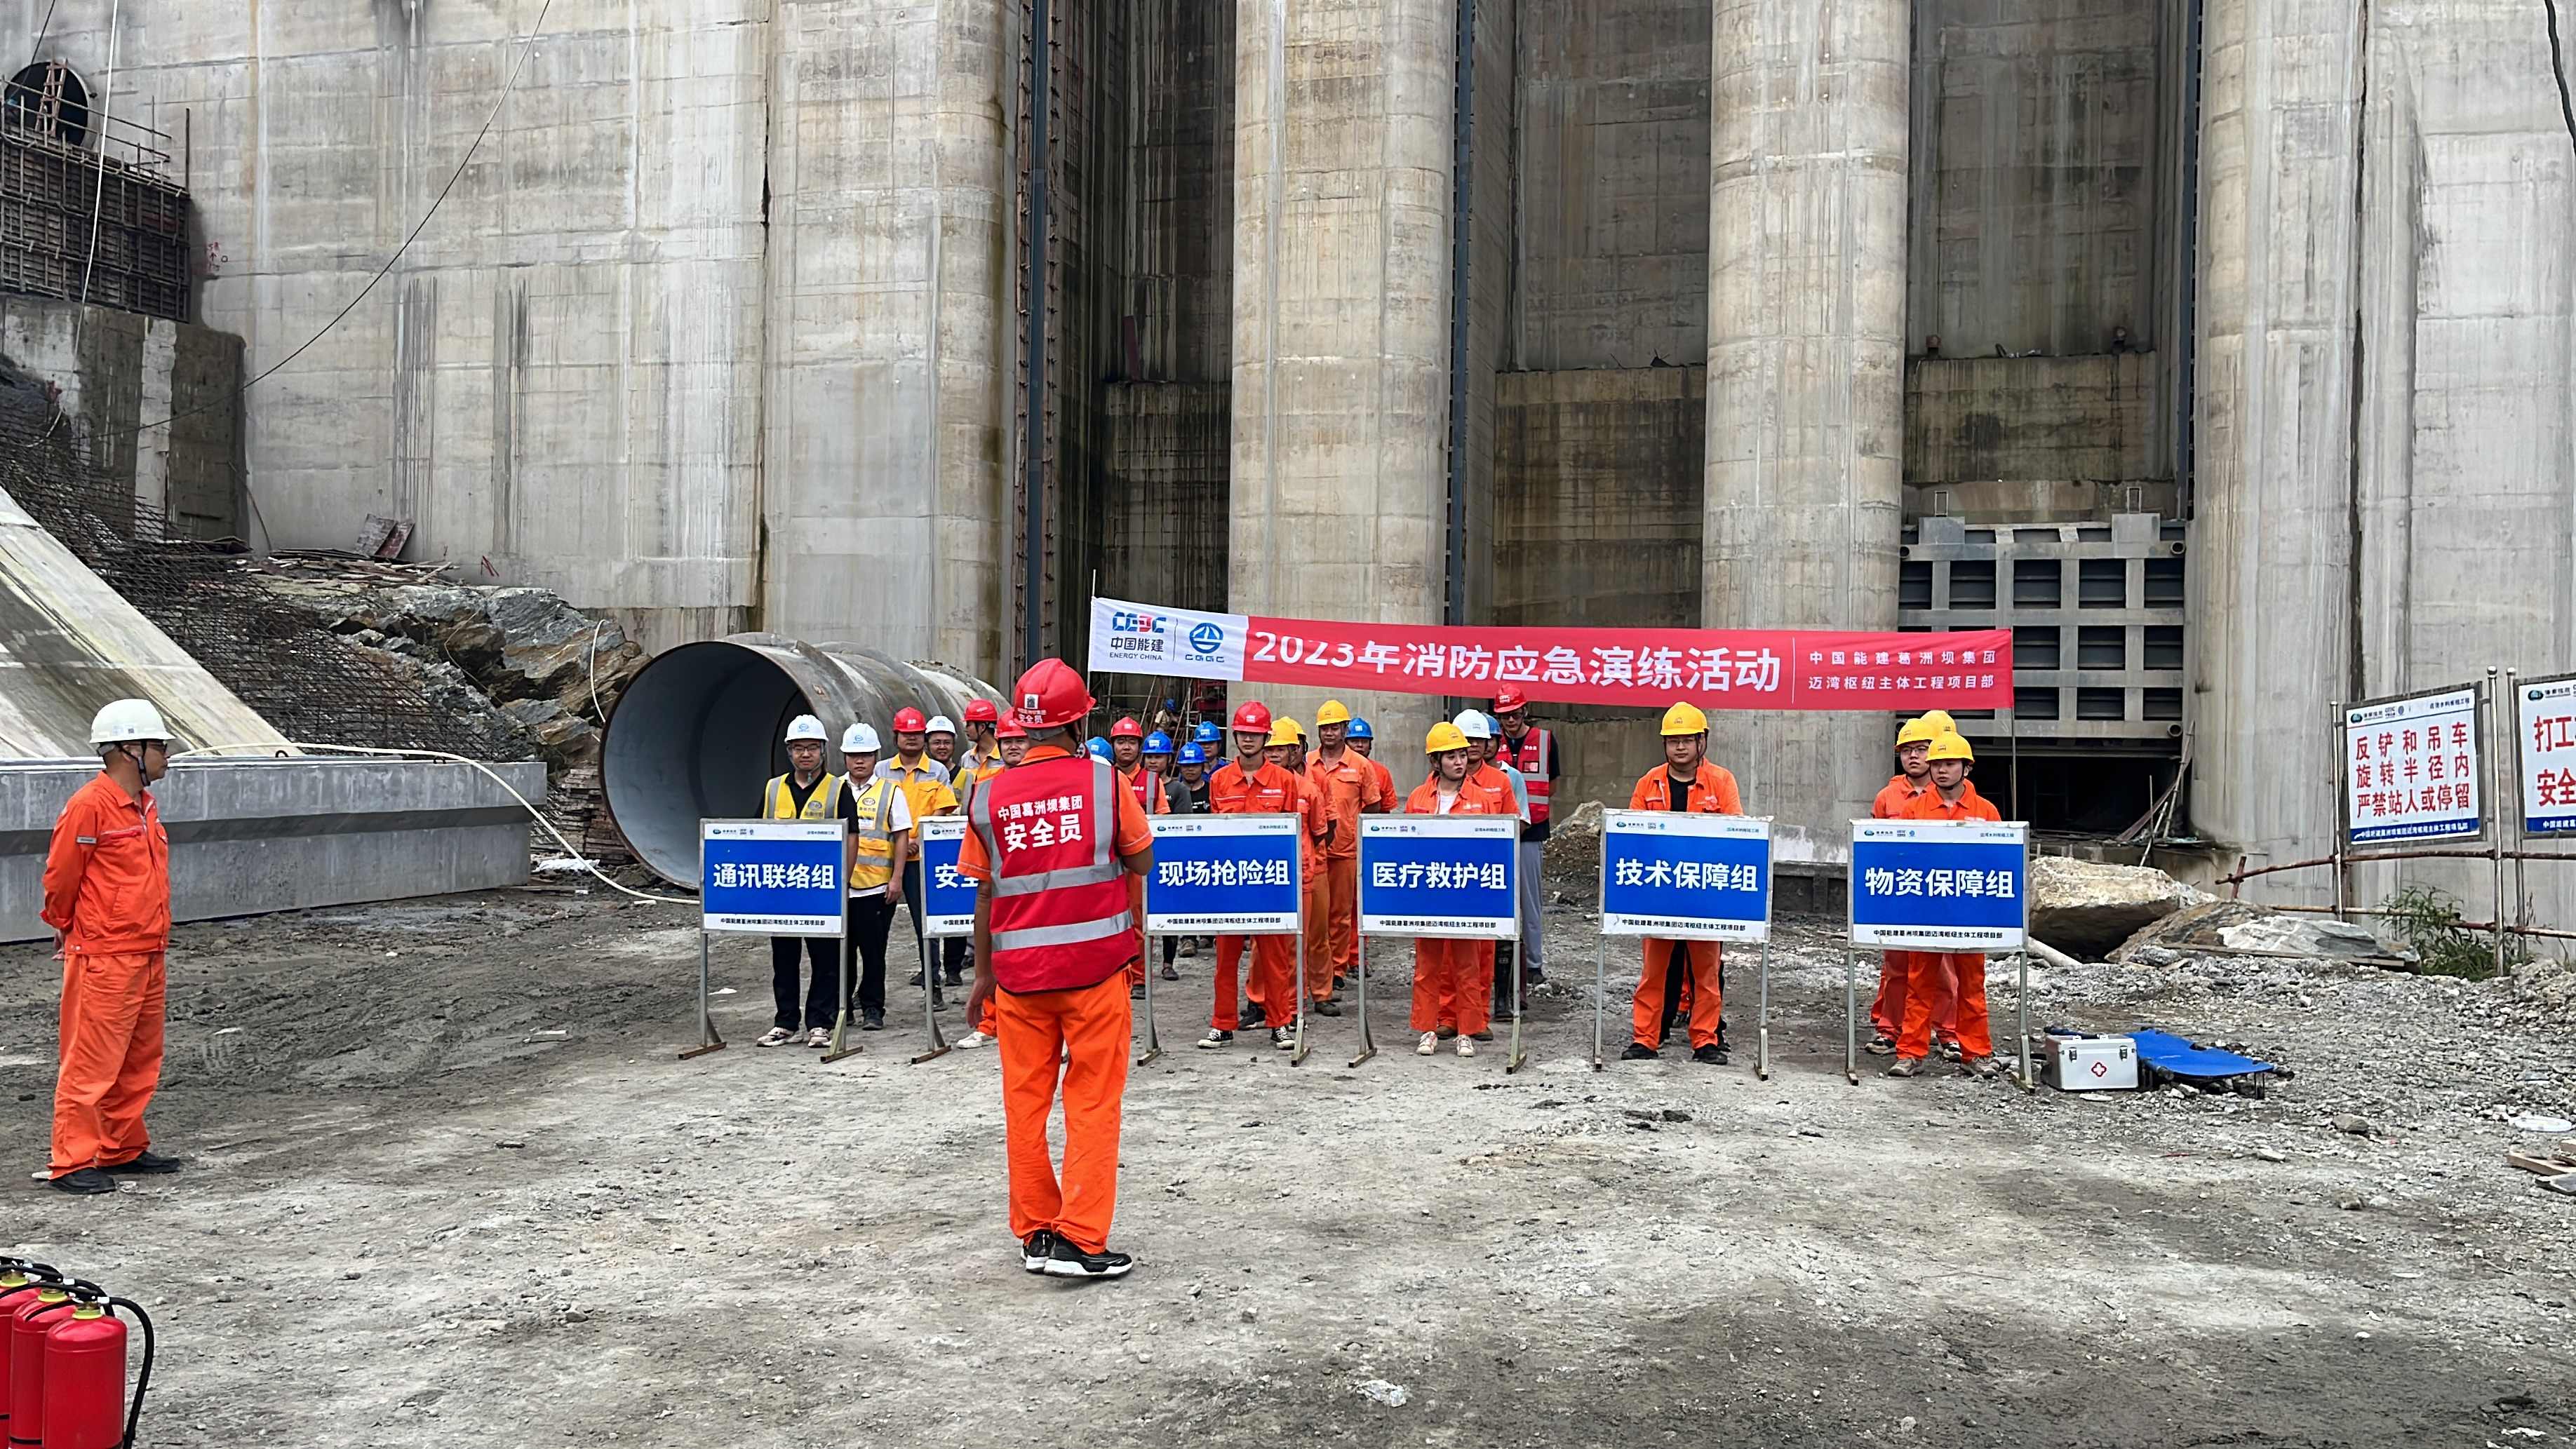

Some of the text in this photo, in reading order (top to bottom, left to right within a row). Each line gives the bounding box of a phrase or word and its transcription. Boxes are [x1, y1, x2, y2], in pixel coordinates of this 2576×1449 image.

[1111, 637, 1165, 652] 中国能建
[1140, 652, 1162, 661] CHINA
[1186, 654, 1225, 663] CGGC
[1809, 651, 1996, 665] 中国能建葛洲坝集团
[1253, 631, 1780, 692] 2023年消防应急演练活动
[1809, 675, 1994, 690] 迈湾枢纽主体工程项目部
[2356, 722, 2468, 761] 反铲和吊车
[2533, 715, 2576, 753] 打工
[2356, 751, 2469, 789] 旋转半径内
[998, 795, 1083, 822] 中国葛洲坝集团
[2357, 783, 2470, 819] 严禁站人或停留
[1004, 813, 1083, 853] 安全员
[713, 863, 836, 889] 通讯联络组
[1158, 859, 1291, 887] 现场抢险组
[1373, 861, 1507, 890] 医疗救护组
[1616, 858, 1758, 892] 技术保障组
[1865, 868, 2015, 898] 物资保障组
